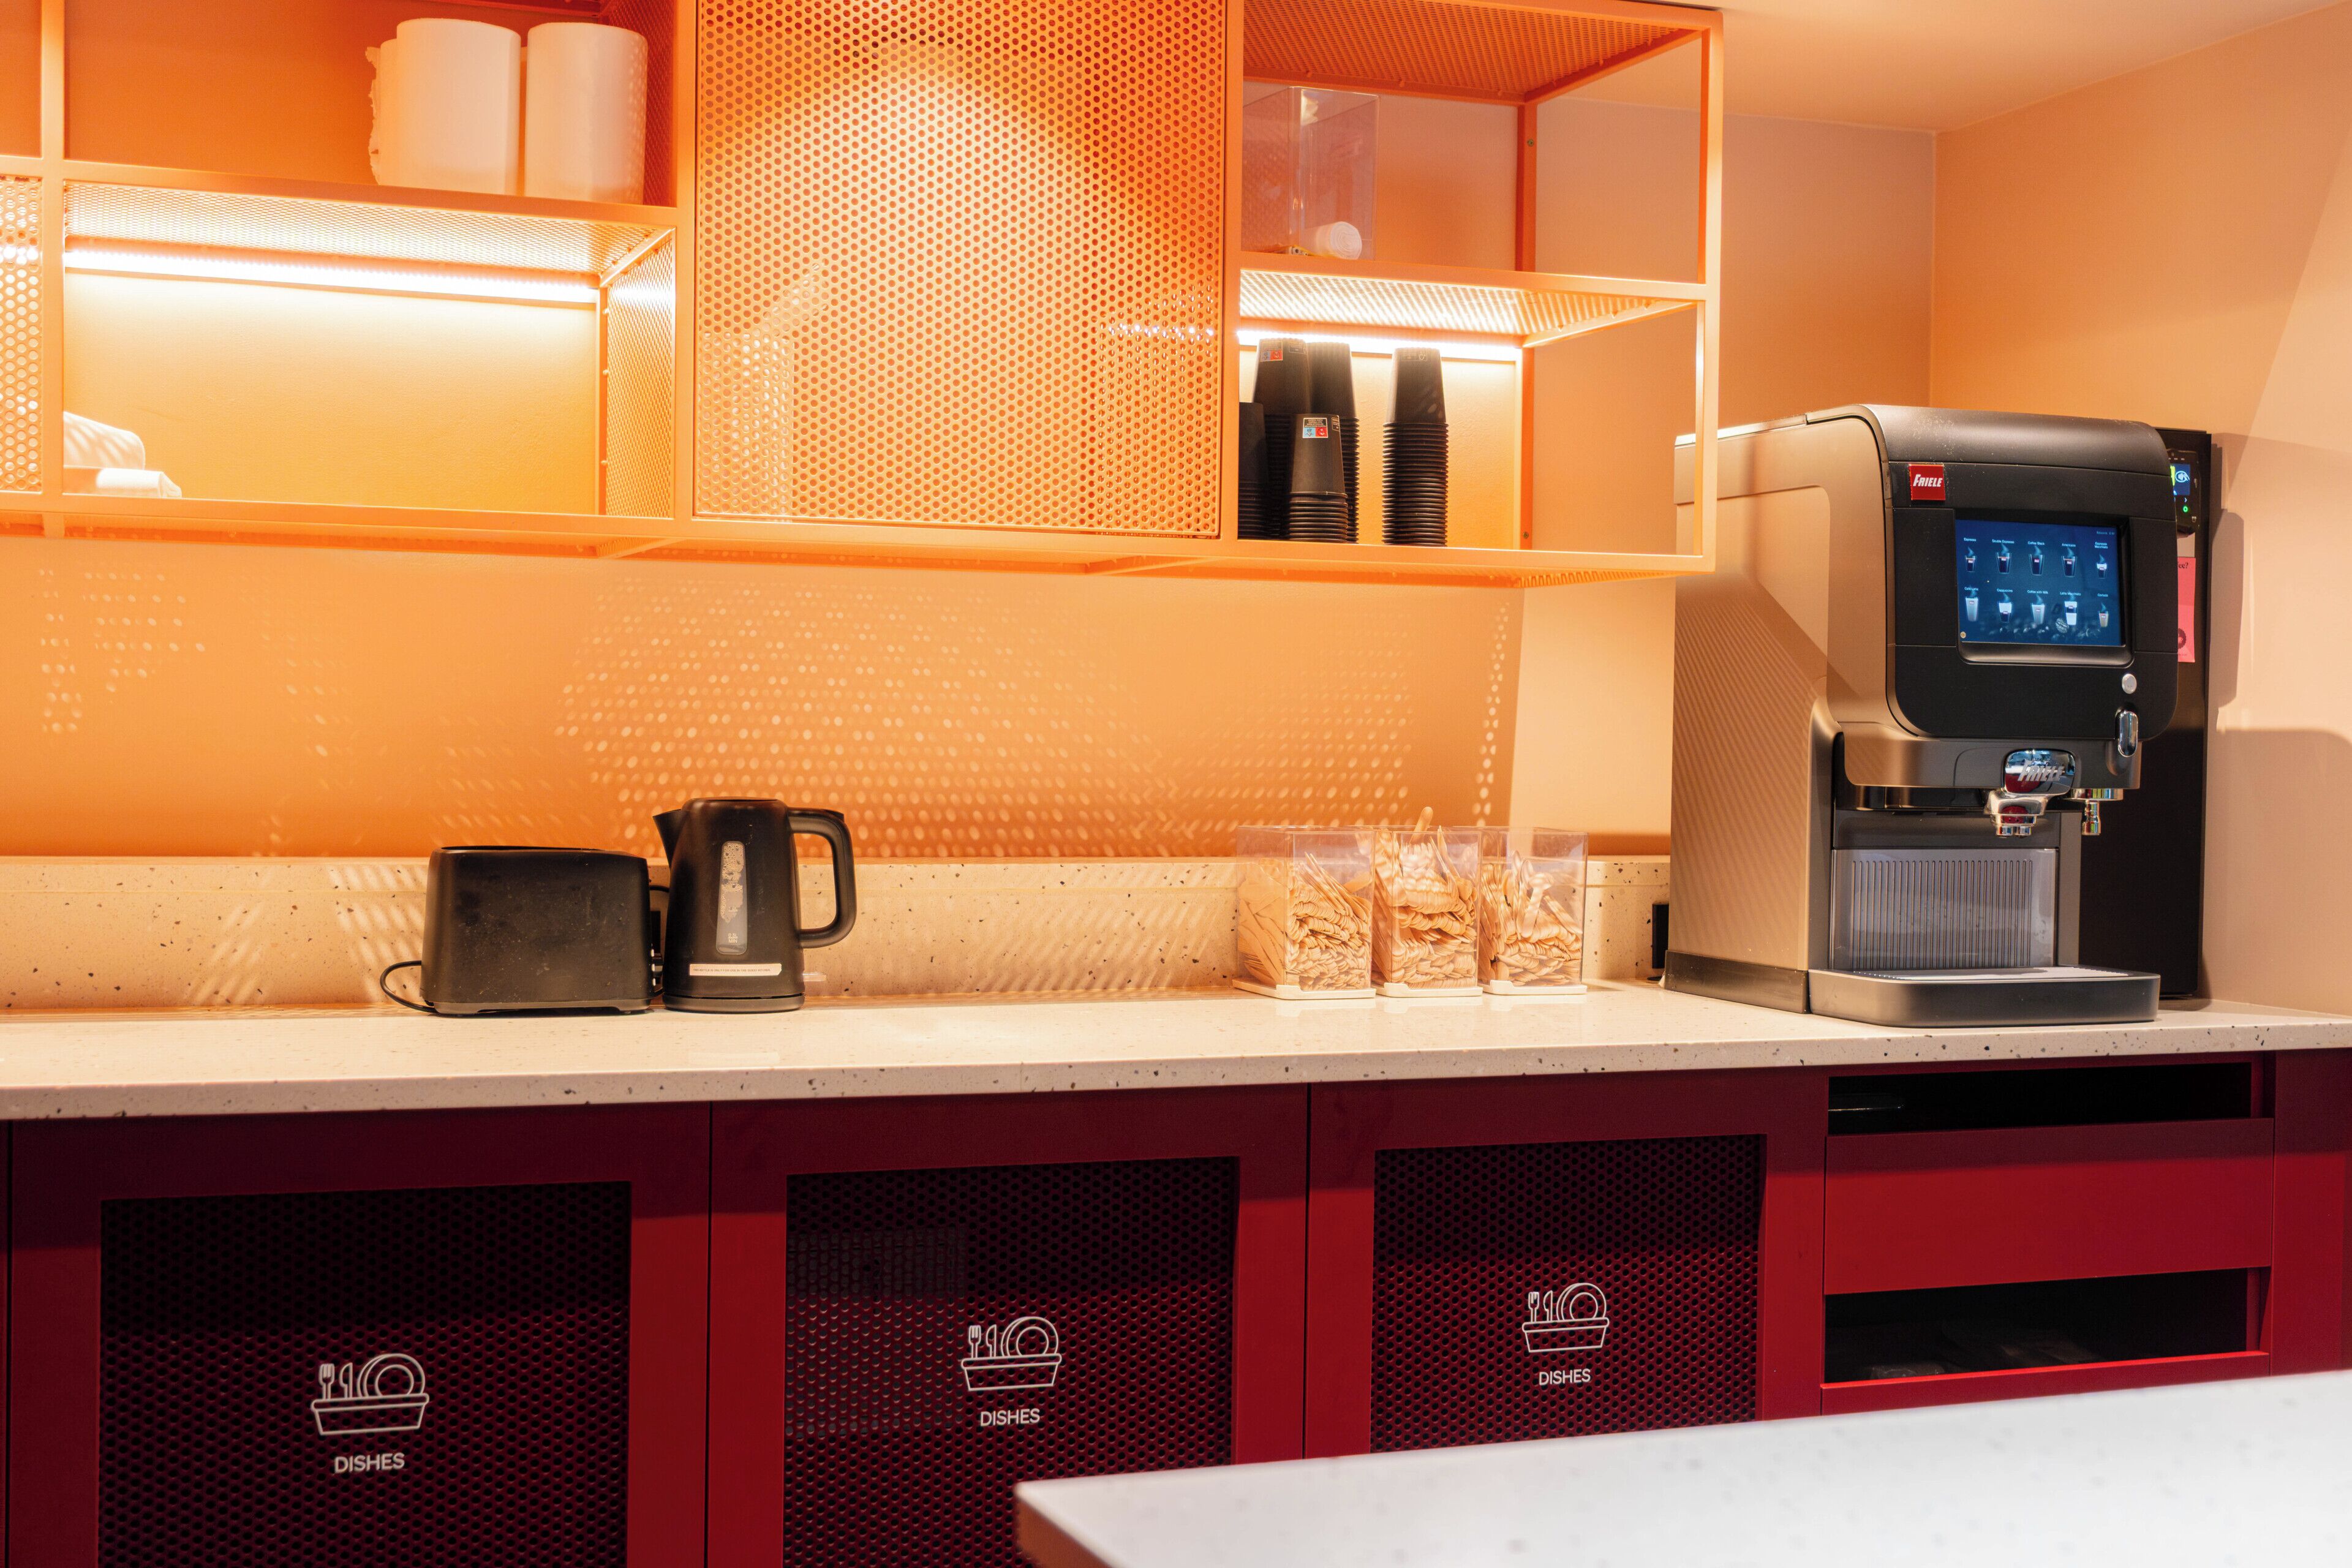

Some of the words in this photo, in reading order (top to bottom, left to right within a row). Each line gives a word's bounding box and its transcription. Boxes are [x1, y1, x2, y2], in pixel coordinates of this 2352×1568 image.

[1913, 473, 1943, 487] FRIELE
[1539, 1368, 1591, 1385] DISHES
[981, 1408, 1040, 1427] DISHES
[334, 1452, 405, 1474] DISHES
